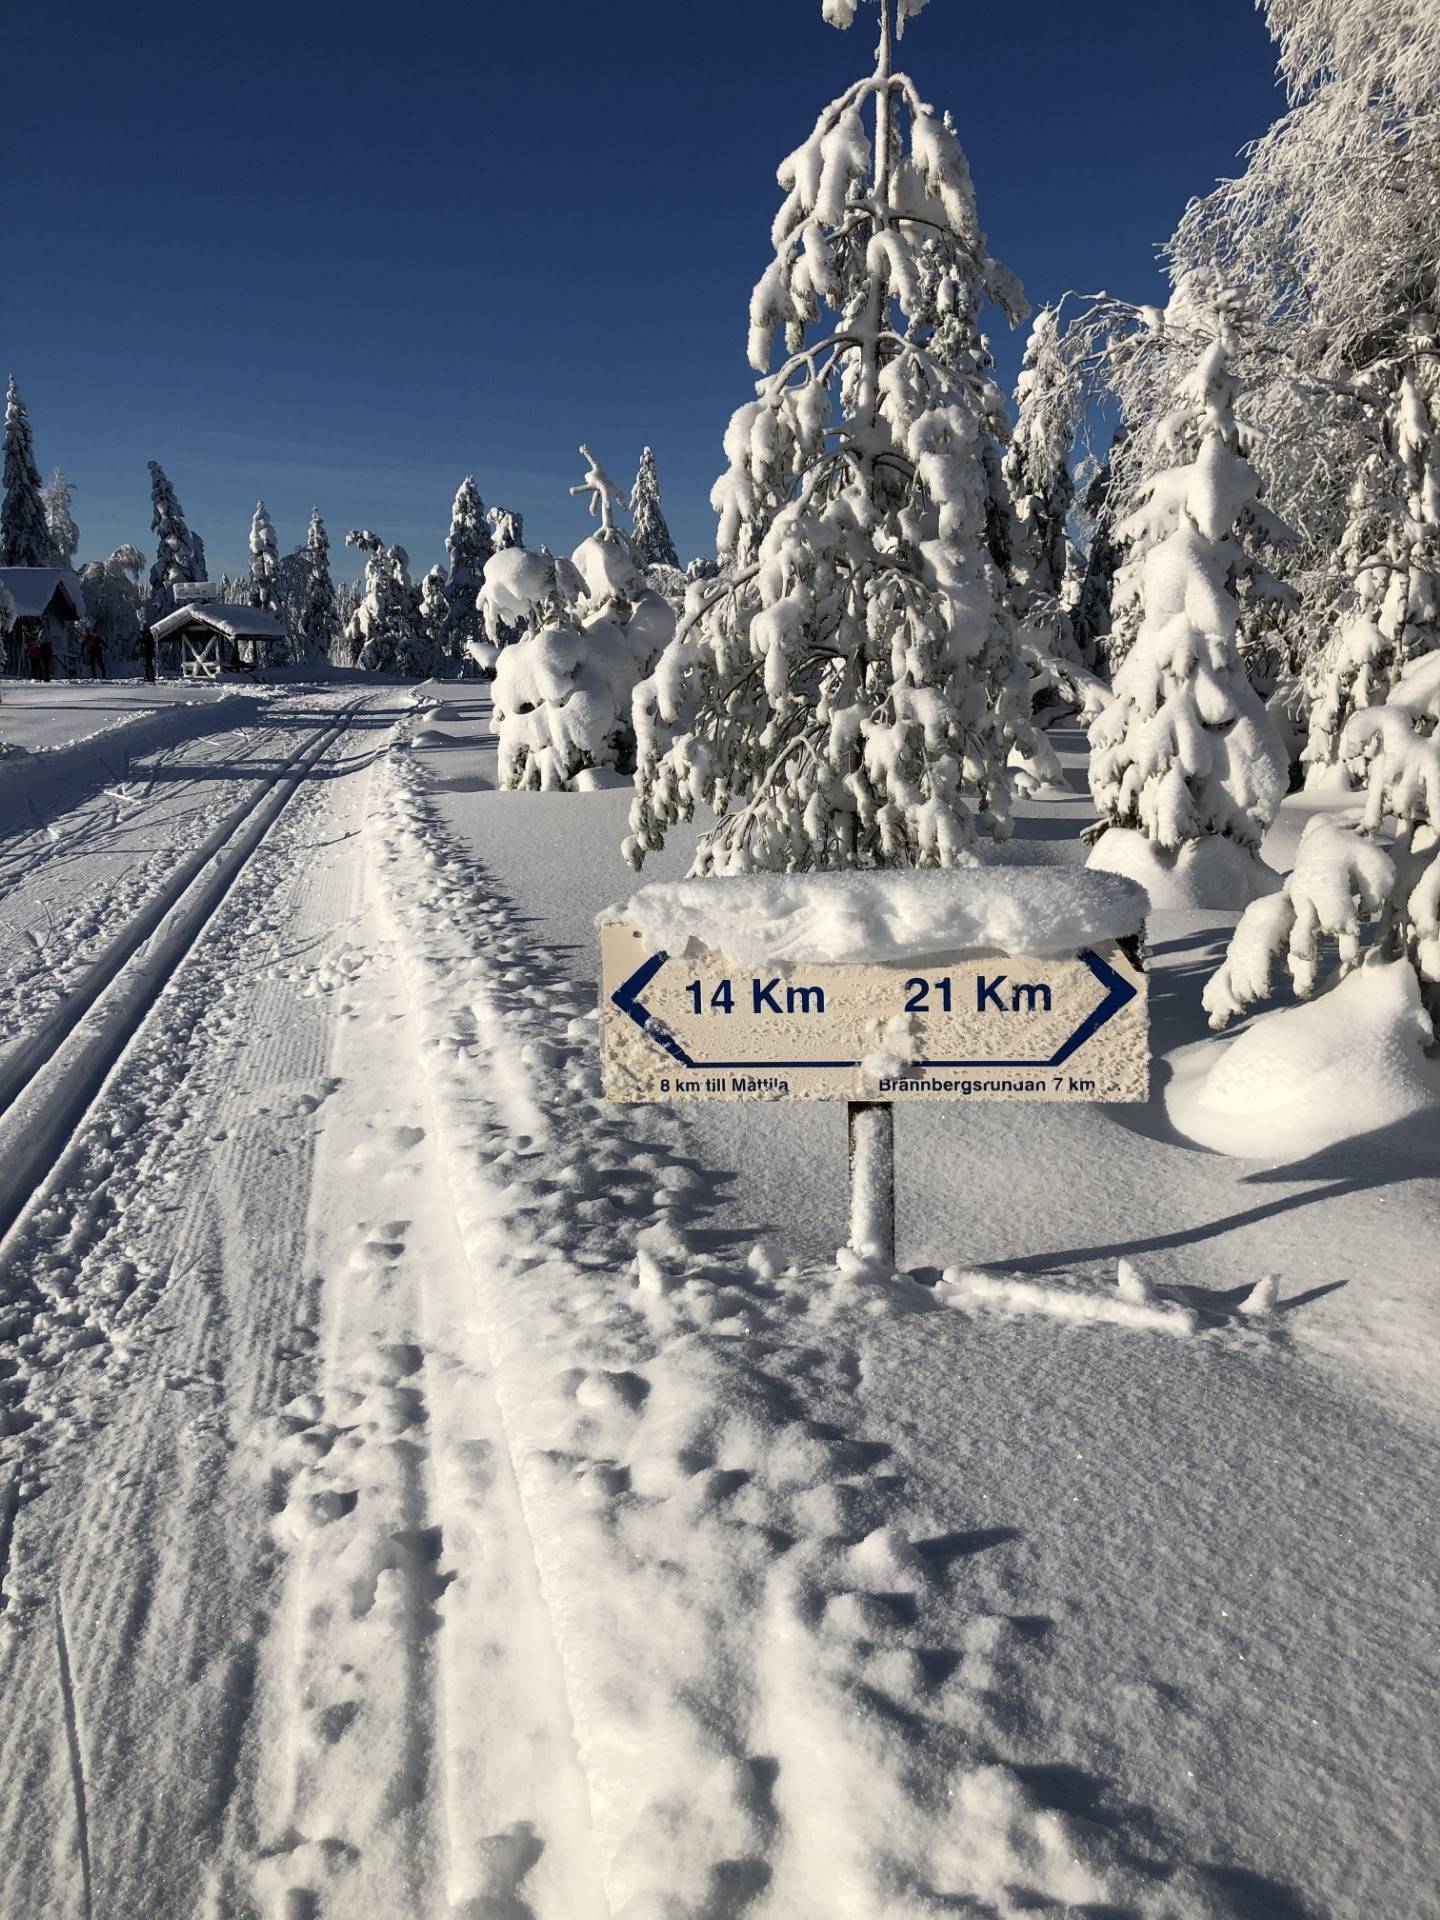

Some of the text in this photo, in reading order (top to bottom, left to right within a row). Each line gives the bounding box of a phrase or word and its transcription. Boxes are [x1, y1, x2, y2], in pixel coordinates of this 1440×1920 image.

[685, 978, 826, 1014] 14 Km
[904, 975, 1053, 1012] 21 Km
[660, 1078, 671, 1092] 8
[676, 1078, 700, 1092] km
[706, 1078, 726, 1092] till
[879, 1077, 1096, 1094] Brännbergsrundan 7 km
